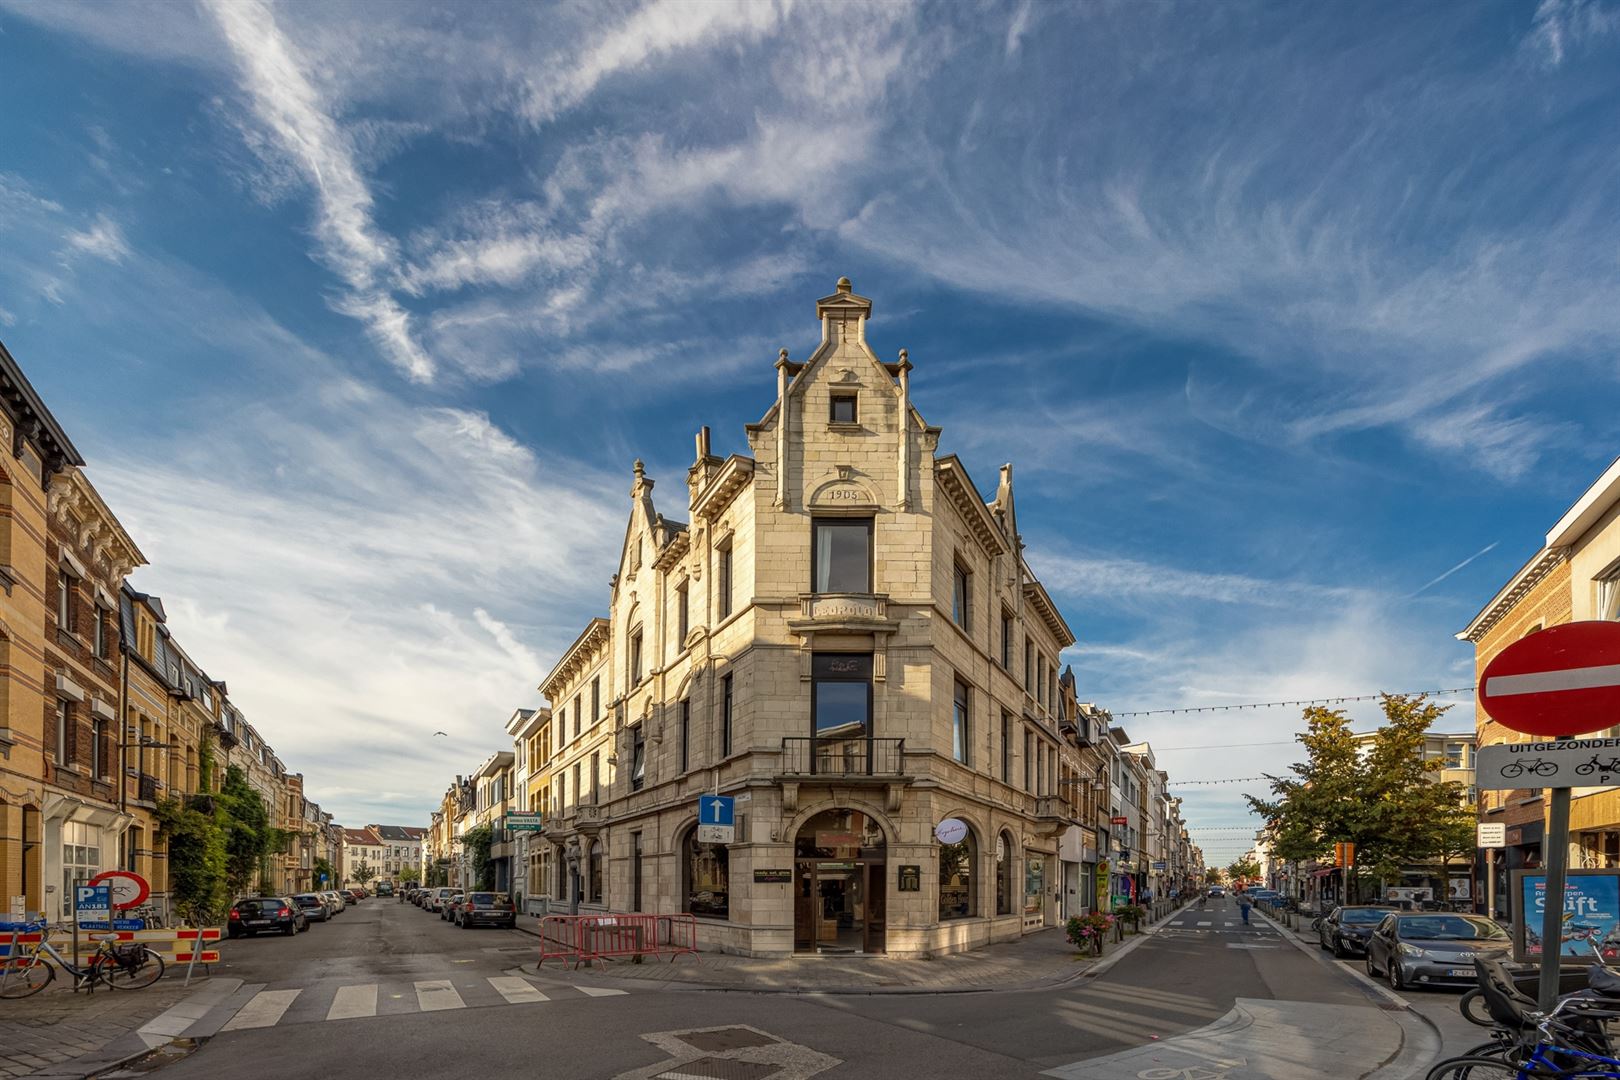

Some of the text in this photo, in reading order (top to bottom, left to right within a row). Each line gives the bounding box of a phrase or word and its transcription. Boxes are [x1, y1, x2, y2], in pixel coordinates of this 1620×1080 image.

[829, 490, 857, 500] 1905
[1600, 775, 1610, 784] P
[1535, 896, 1598, 916] Sift
